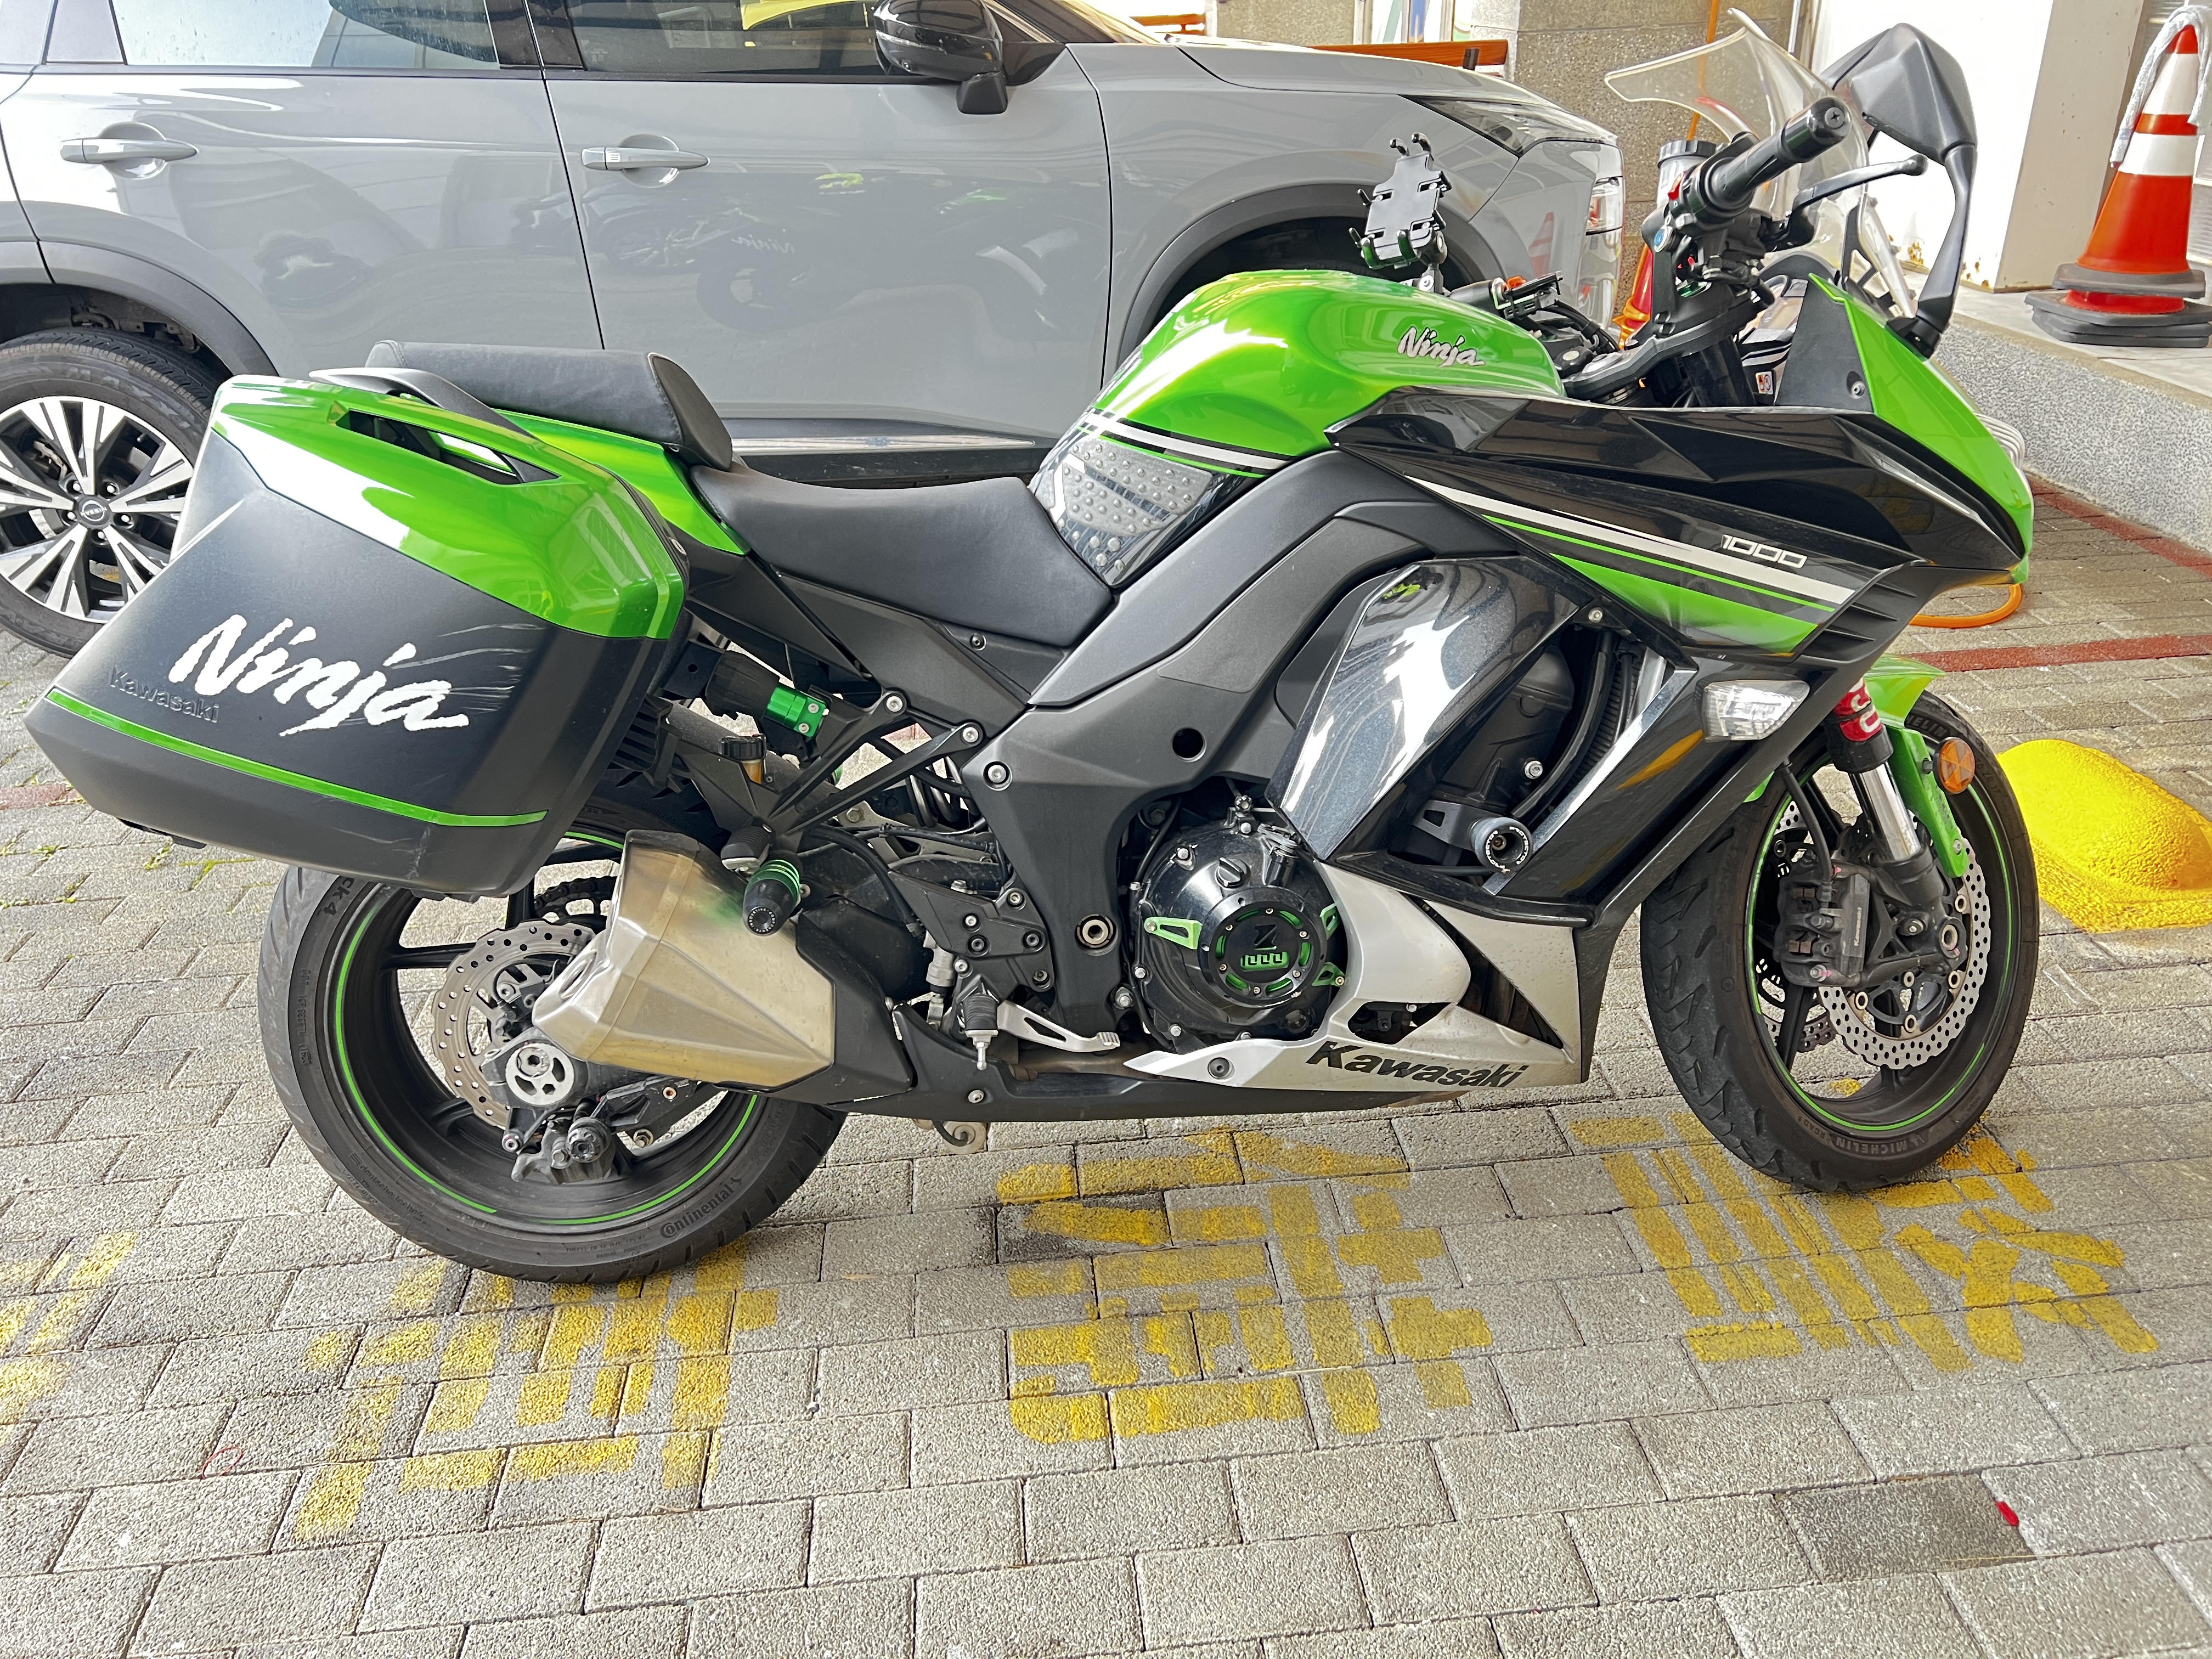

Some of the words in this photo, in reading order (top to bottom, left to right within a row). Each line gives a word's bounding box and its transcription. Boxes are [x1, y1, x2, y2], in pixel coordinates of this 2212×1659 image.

[1397, 326, 1486, 368] Ninja
[1720, 534, 1808, 569] 1000
[110, 668, 219, 723] Kawasaki
[168, 613, 470, 737] Ninja
[1485, 830, 1505, 870] PROTECTOR
[1509, 826, 1529, 865] PROTECTOR
[323, 901, 337, 916] 4
[1306, 1040, 1530, 1088] Kawasaki
[1836, 1137, 1908, 1155] MICHELIN
[660, 1183, 734, 1238] Continental
